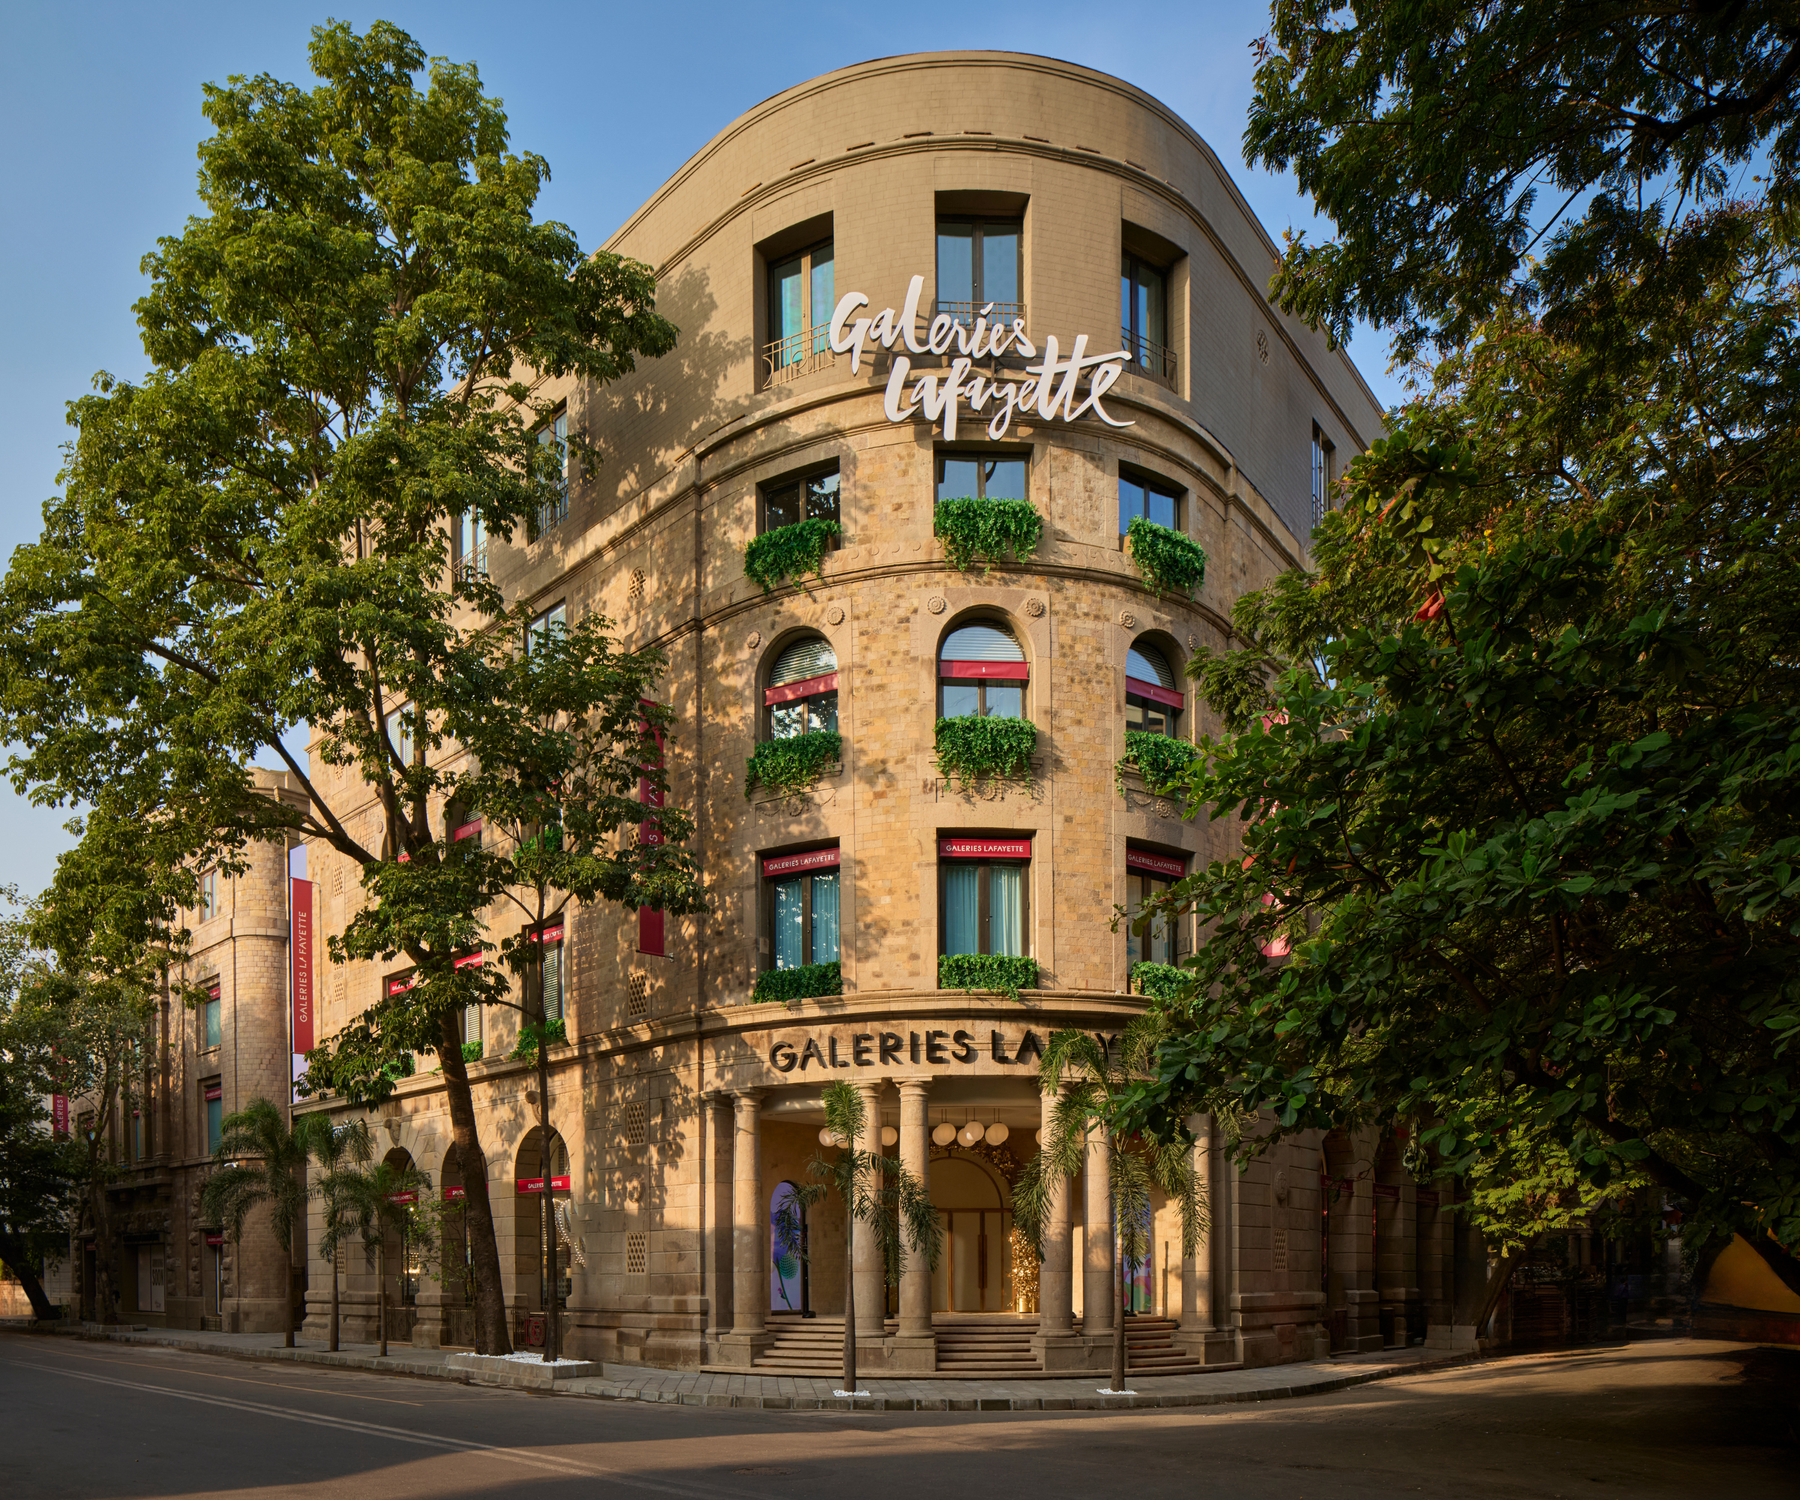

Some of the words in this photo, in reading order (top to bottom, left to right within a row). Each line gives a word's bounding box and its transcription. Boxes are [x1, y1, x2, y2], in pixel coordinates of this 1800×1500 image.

[830, 275, 1036, 375] Galeries
[884, 335, 1136, 441] Lafayette
[768, 859, 799, 871] GALERIES
[800, 853, 835, 865] LAFAYETTE
[945, 844, 982, 852] GALERIES
[1127, 853, 1153, 866] GALERIES
[1153, 859, 1182, 872] LAFAYETTE
[299, 971, 308, 1022] GALERIES
[768, 1029, 973, 1072] GALERIES
[56, 1099, 64, 1132] ALERIES
